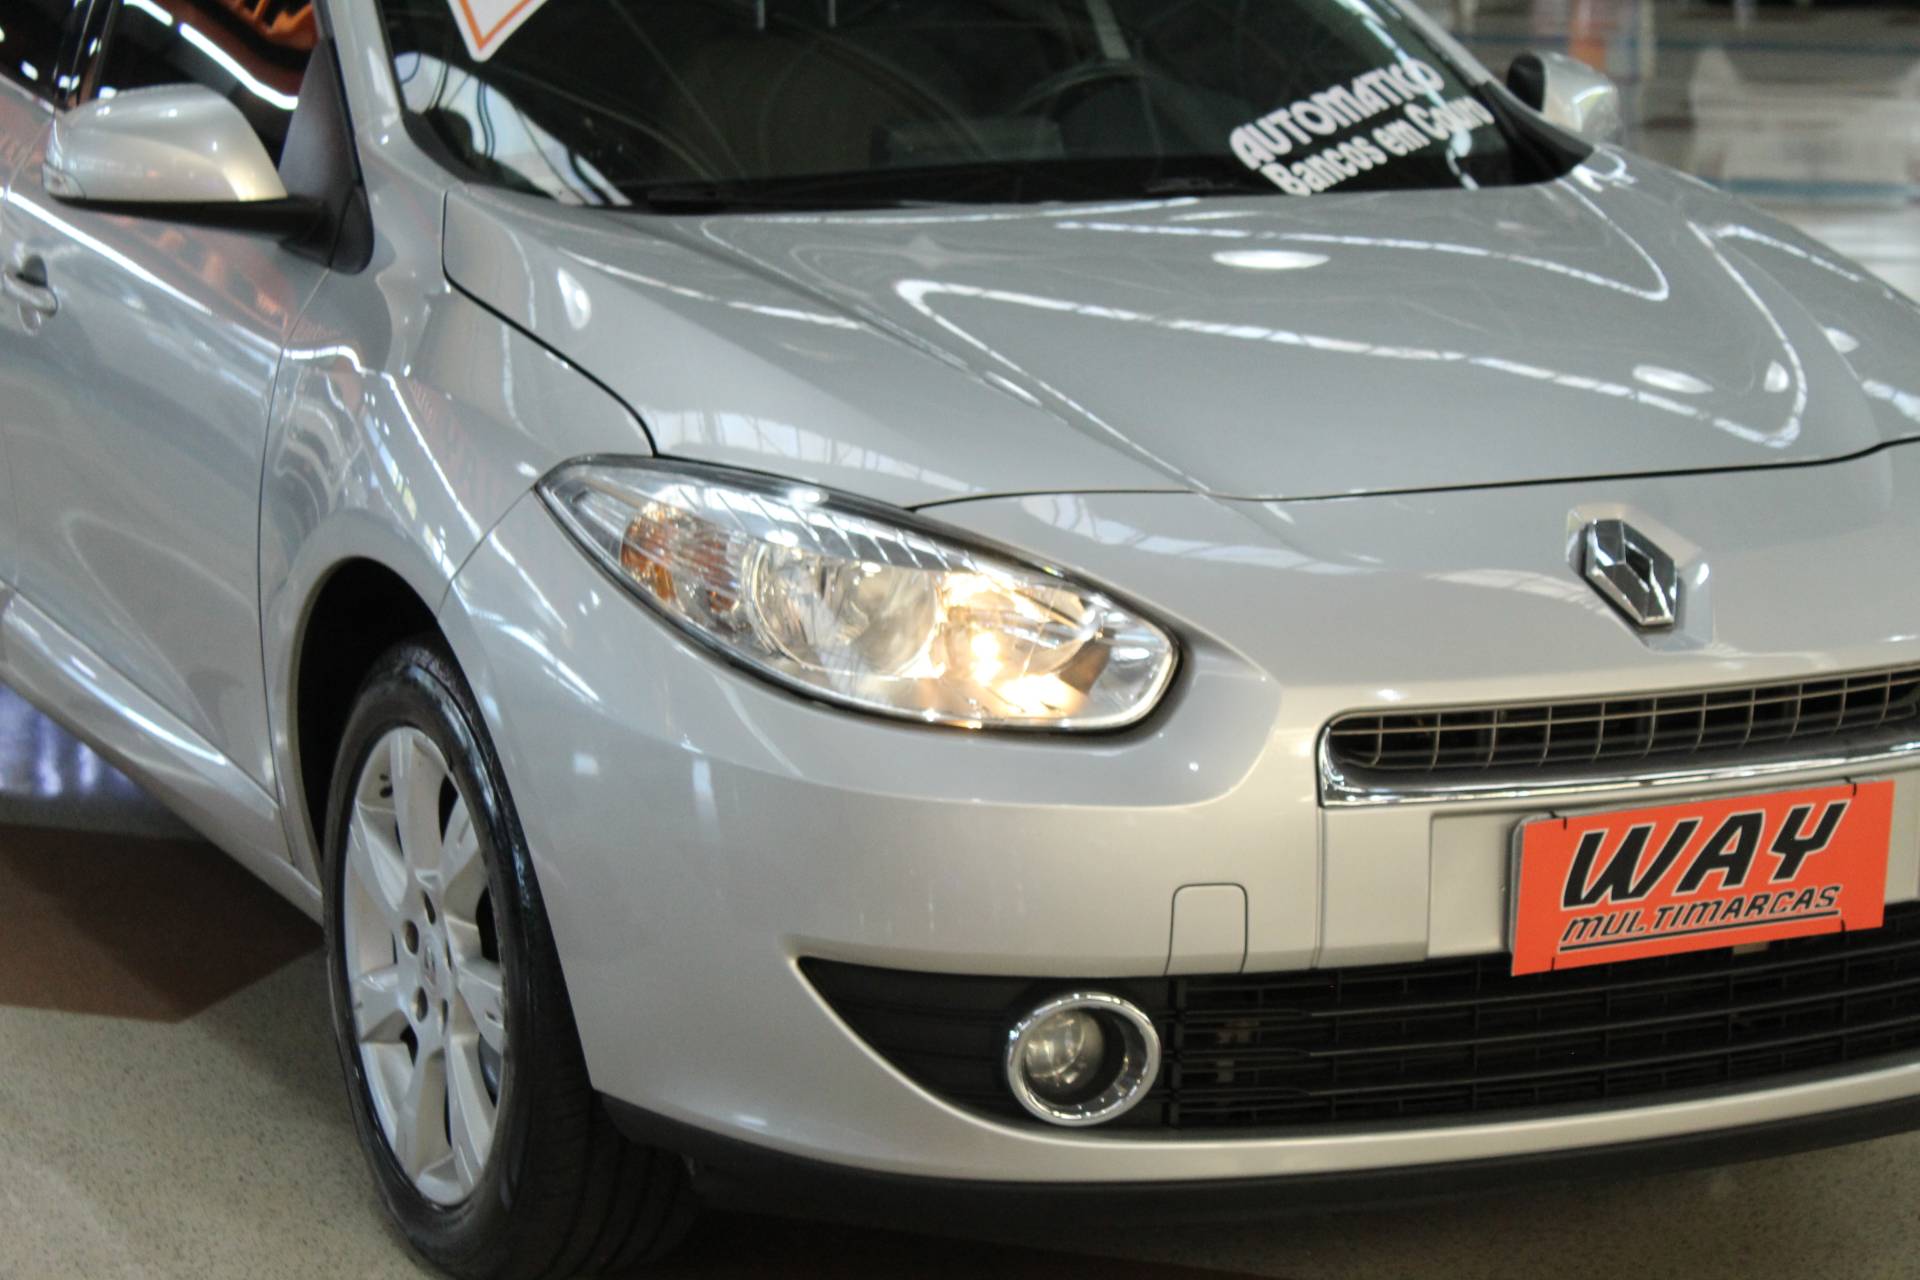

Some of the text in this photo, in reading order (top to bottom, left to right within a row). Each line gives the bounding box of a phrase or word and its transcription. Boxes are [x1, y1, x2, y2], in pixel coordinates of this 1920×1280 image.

[1260, 96, 1495, 197] Bancos em Couro
[1561, 799, 1850, 911] WAY
[1561, 885, 1841, 942] MULTIMARCAS
